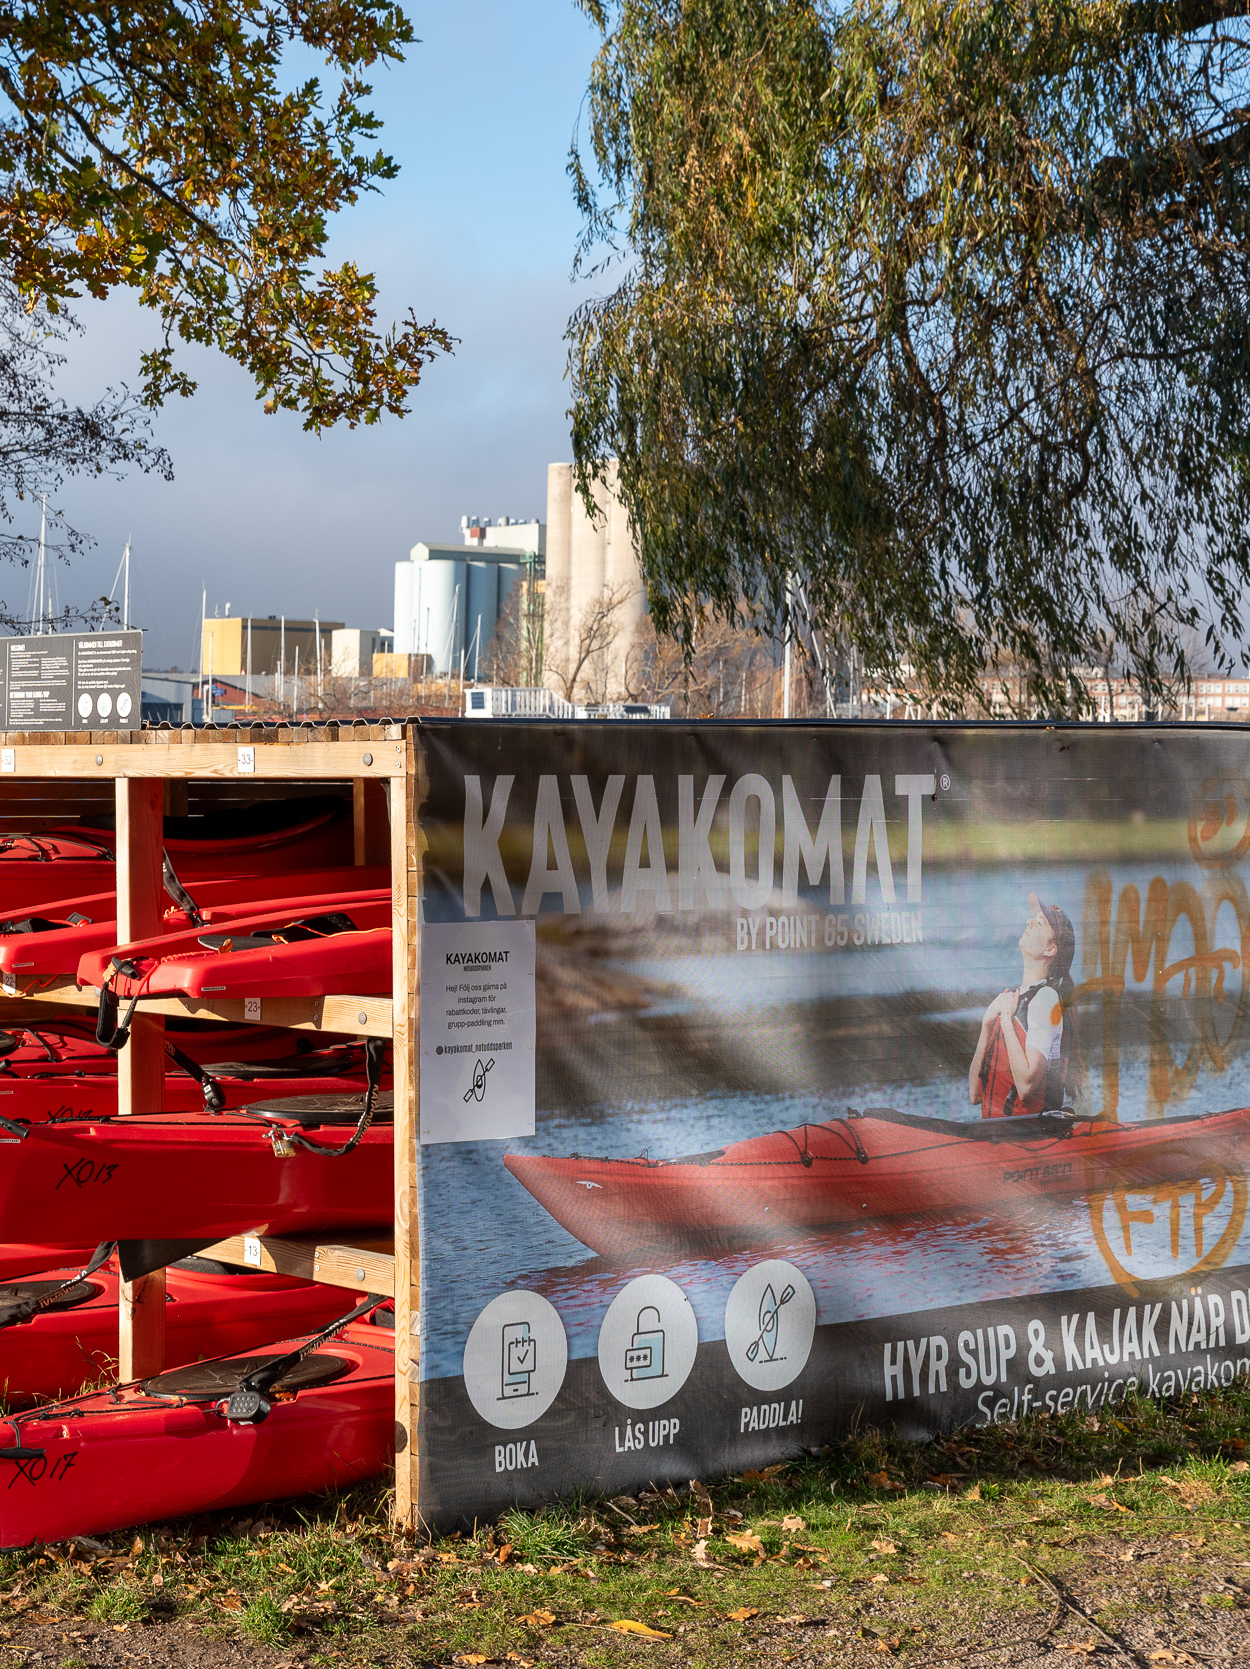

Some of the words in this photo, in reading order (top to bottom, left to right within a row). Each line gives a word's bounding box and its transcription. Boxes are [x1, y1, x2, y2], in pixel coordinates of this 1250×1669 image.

[241, 753, 251, 765] 33
[736, 917, 759, 950] BY
[765, 914, 819, 949] POINT
[823, 913, 849, 947] 65
[853, 911, 923, 946] SWEDEN
[446, 951, 510, 965] KAYAKOMAT
[5, 976, 14, 986] 22
[500, 982, 508, 991] på
[247, 1001, 258, 1012] 23
[448, 1019, 492, 1029] grupp-paddling
[249, 1245, 258, 1257] 13
[883, 1335, 948, 1401] HYR
[958, 1324, 1017, 1389] SUP
[1027, 1318, 1056, 1377] &
[1061, 1302, 1163, 1371] KAJAK
[1169, 1286, 1226, 1355] NÄR
[1230, 1288, 1250, 1345] D
[977, 1371, 1139, 1426] Self-service
[740, 1400, 804, 1432] PADDLA!
[614, 1418, 644, 1453] LÅS
[649, 1418, 680, 1447] UPP
[494, 1440, 539, 1472] BOKA
